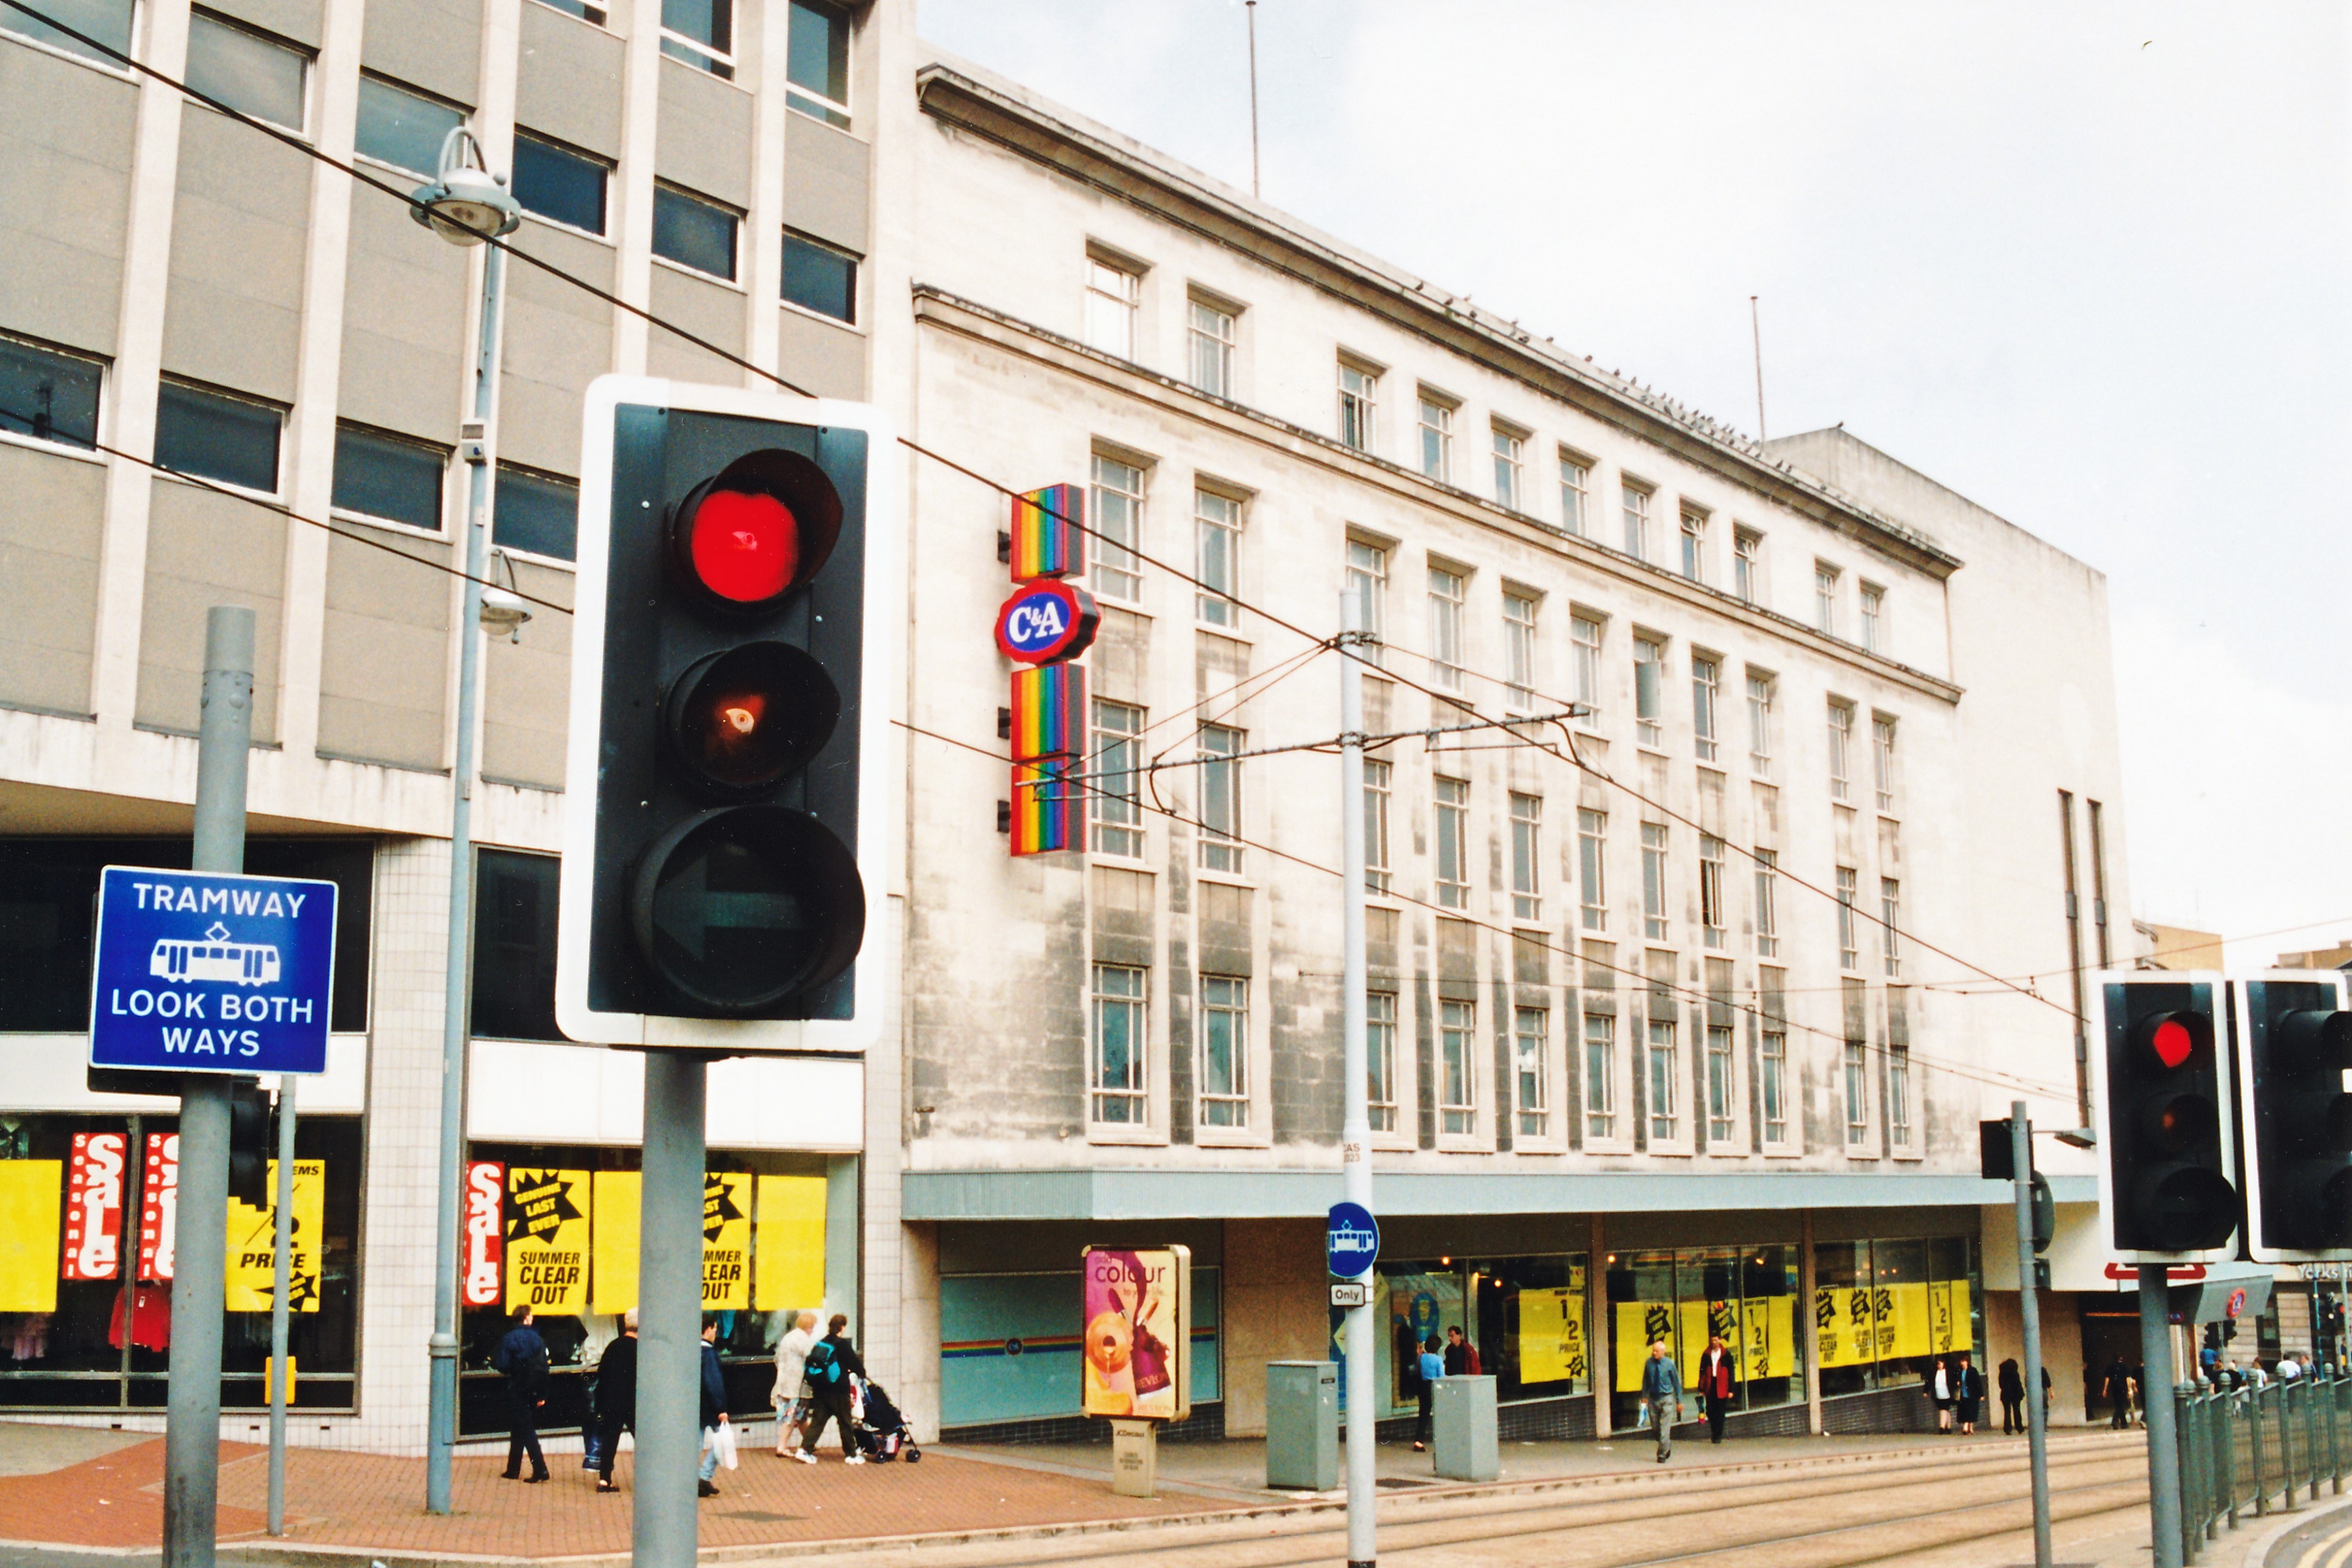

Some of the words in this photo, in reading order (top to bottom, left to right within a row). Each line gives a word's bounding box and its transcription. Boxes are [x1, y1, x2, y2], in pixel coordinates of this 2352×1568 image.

[1009, 601, 1064, 642] C&A
[133, 883, 306, 918] TRAMWAY
[112, 988, 206, 1019] LOOK
[220, 994, 313, 1023] BOTH
[162, 1026, 261, 1056] WAYS
[514, 1182, 562, 1205] GENUINE
[525, 1198, 556, 1217] LAST
[527, 1213, 561, 1234] EVER
[240, 1253, 306, 1268] PRIE
[519, 1252, 580, 1265] SUMMER
[703, 1250, 742, 1262] MMER
[519, 1266, 580, 1284] CLEAR
[702, 1264, 741, 1281] LEAR
[1095, 1261, 1166, 1283] colour
[531, 1286, 568, 1305] OUT
[1335, 1290, 1360, 1301] Only
